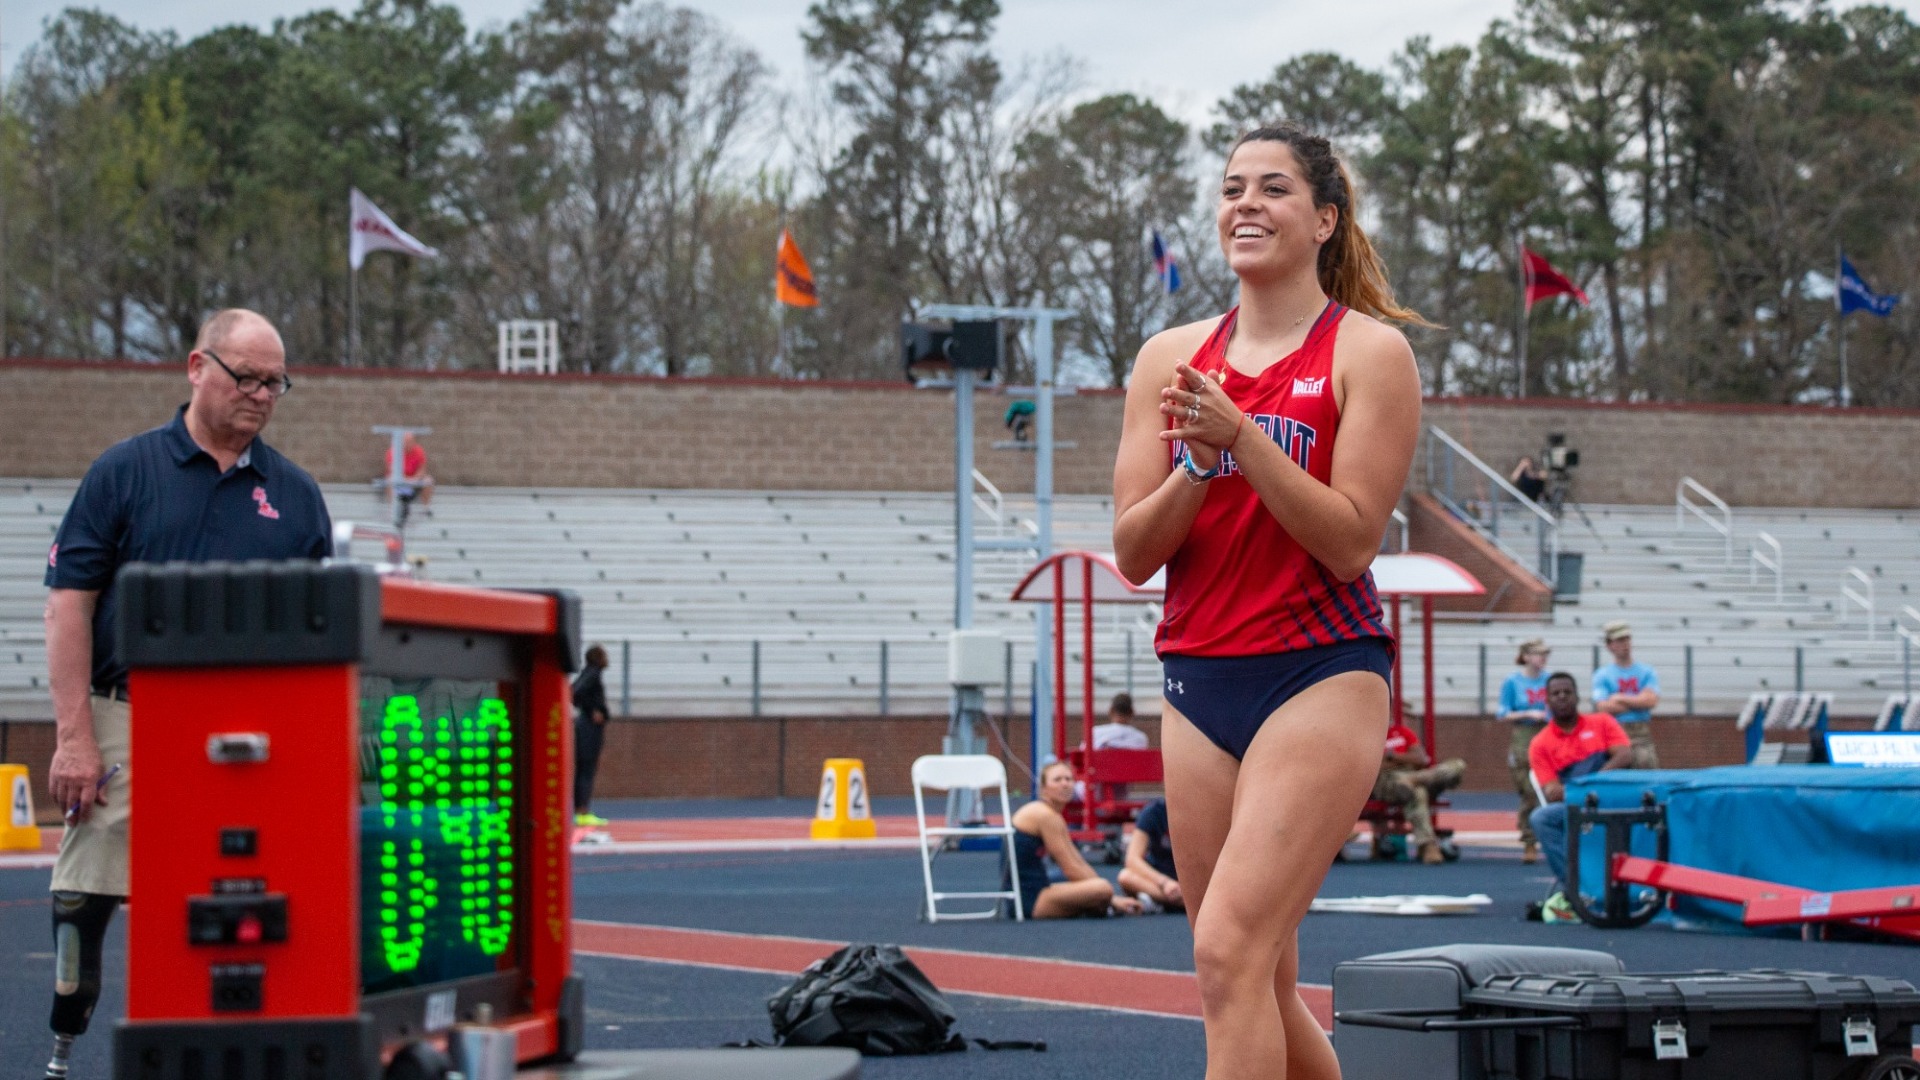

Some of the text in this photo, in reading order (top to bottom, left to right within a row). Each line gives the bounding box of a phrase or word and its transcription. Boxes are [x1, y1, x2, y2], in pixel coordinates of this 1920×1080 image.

[1291, 377, 1327, 394] VALLEY
[1617, 677, 1640, 694] M
[14, 783, 28, 816] 4
[823, 777, 835, 808] 2
[851, 777, 864, 809] 2
